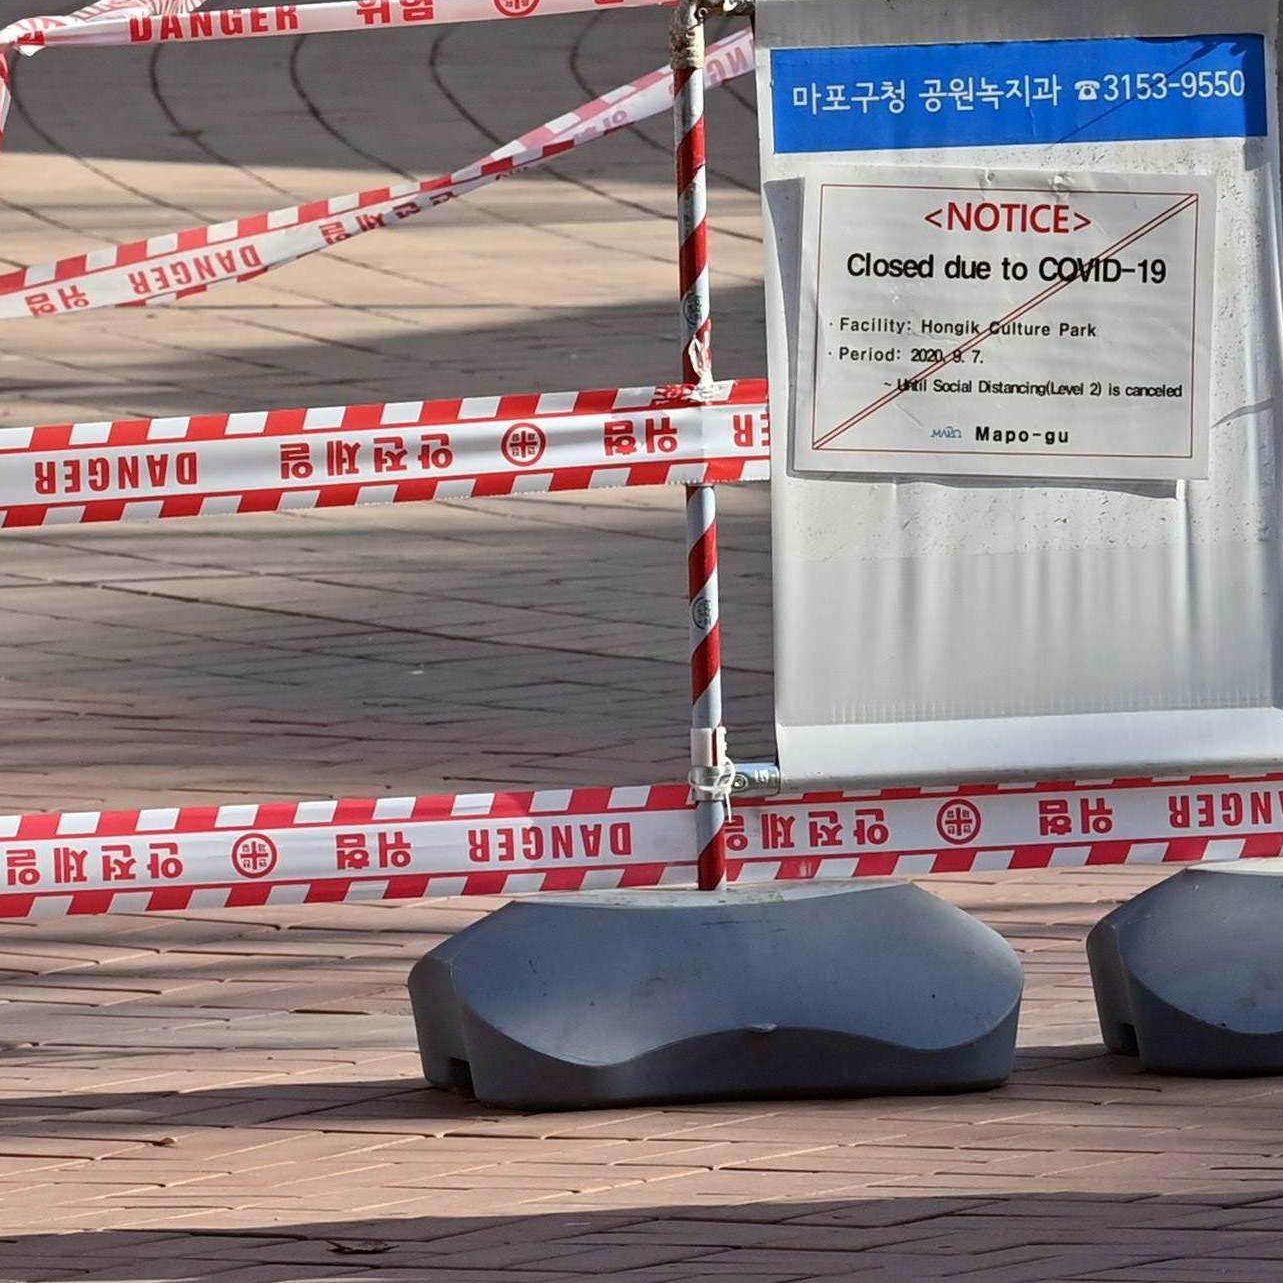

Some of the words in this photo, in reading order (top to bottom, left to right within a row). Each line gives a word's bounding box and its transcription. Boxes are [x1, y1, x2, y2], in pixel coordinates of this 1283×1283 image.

[129, 4, 299, 43] DANGER
[792, 81, 905, 114] 마포구청
[918, 75, 1062, 111] 공원녹지과
[925, 203, 1091, 235] <NOTICE>
[126, 243, 264, 296] DANGER
[847, 253, 934, 280] Closed
[946, 256, 990, 281] due
[1002, 257, 1027, 281] to
[1039, 256, 1166, 284] COVID-19
[24, 282, 91, 316] 위험
[840, 318, 912, 336] Facility:
[921, 320, 980, 339] Hongik
[989, 321, 1050, 337] Culture
[1059, 323, 1097, 338] Park
[840, 347, 901, 363] Period:
[972, 350, 984, 365] 7.
[897, 378, 928, 393] Until
[933, 379, 972, 394] Social
[978, 380, 1085, 398] Distancing(Level
[1089, 382, 1102, 398] 2)
[1108, 384, 1121, 397] is
[1126, 384, 1183, 398] canceled
[604, 418, 677, 456] 위험
[975, 426, 1069, 445] Mapo-gu
[34, 451, 197, 495] DANGER
[279, 433, 452, 481] 안전제일
[1038, 796, 1113, 836] 위험
[335, 831, 411, 870] 위험
[468, 821, 632, 863] DANGER
[5, 841, 183, 886] 안전제일
